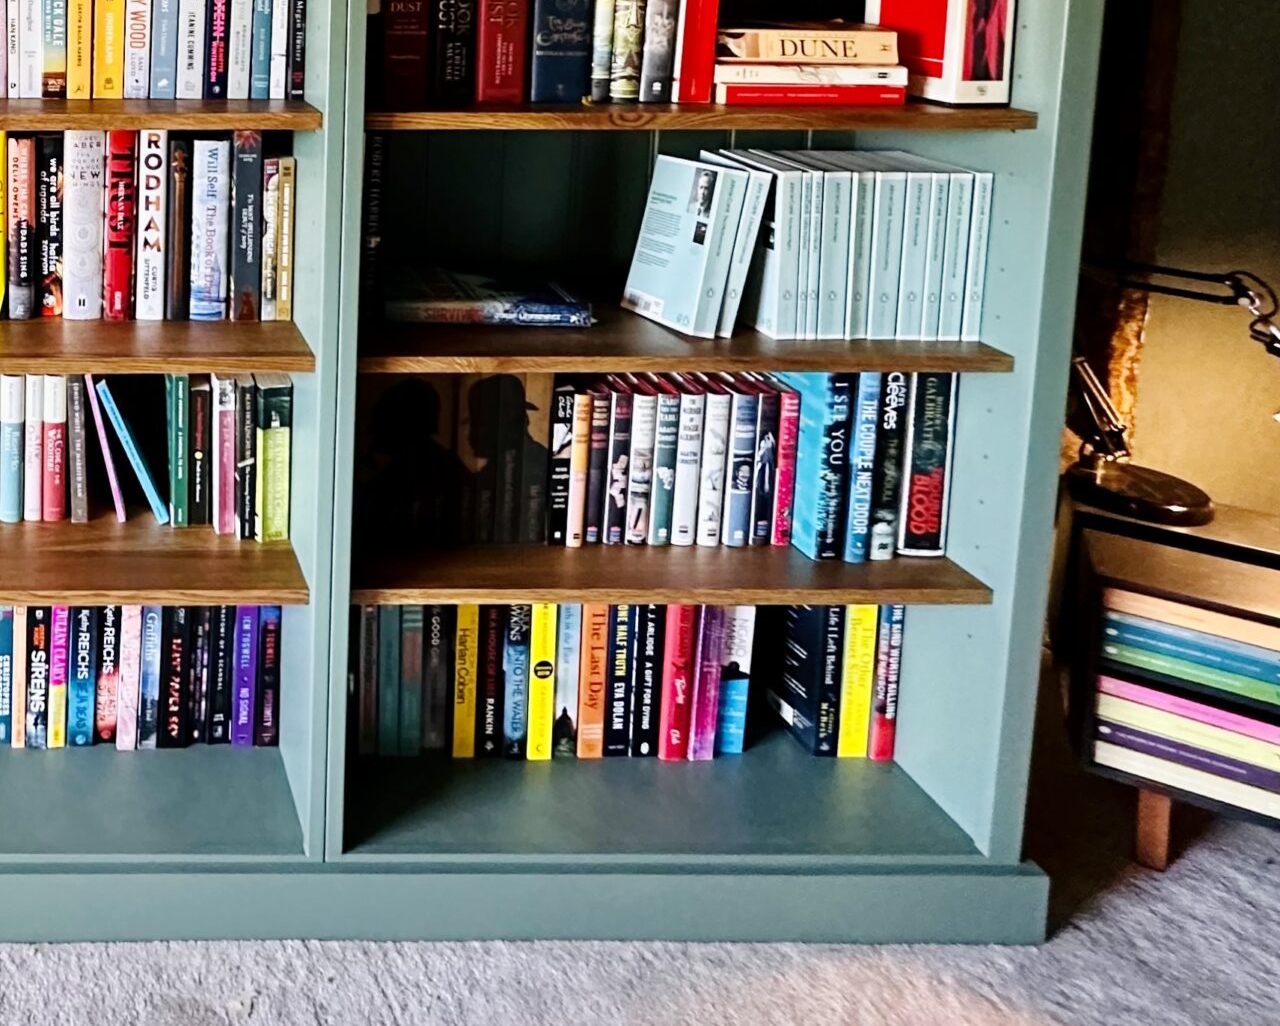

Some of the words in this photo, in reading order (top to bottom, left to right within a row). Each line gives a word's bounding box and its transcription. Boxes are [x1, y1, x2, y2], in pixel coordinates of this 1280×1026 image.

[53, 19, 63, 46] GALE
[130, 11, 147, 49] WOOD
[780, 39, 857, 58] DUNE
[49, 158, 58, 172] we
[49, 175, 58, 193] are
[49, 196, 59, 208] all
[49, 211, 60, 237] birds
[73, 382, 81, 410] EDMUND
[883, 372, 905, 429] Cleeves
[898, 387, 906, 407] Ann
[862, 399, 878, 421] THE
[74, 439, 82, 451] THE
[830, 429, 845, 465] YOU
[857, 424, 877, 469] COUPLE
[75, 453, 83, 477] MARRIED
[75, 479, 83, 497] MAN
[854, 471, 872, 499] NEXT
[910, 474, 930, 535] BLOOD
[853, 502, 871, 535] DOOR
[53, 609, 68, 646] JULIAN
[78, 610, 90, 632] Kathy
[591, 609, 606, 643] The
[616, 605, 629, 623] ONE
[457, 628, 470, 664] Harlan
[615, 625, 628, 646] HALF
[645, 622, 655, 656] ARLIDGE
[52, 648, 67, 682] CLARY
[77, 633, 90, 679] REICHS
[590, 646, 605, 678] Last
[615, 649, 627, 676] TRUTH
[456, 668, 469, 705] Coben
[613, 682, 626, 699] EVA
[644, 670, 653, 687] GIFT
[585, 681, 603, 711] Day
[643, 689, 652, 704] FOR
[484, 698, 494, 735] RANKIN
[612, 701, 625, 730] DOLAN
[641, 706, 651, 730] DYING
